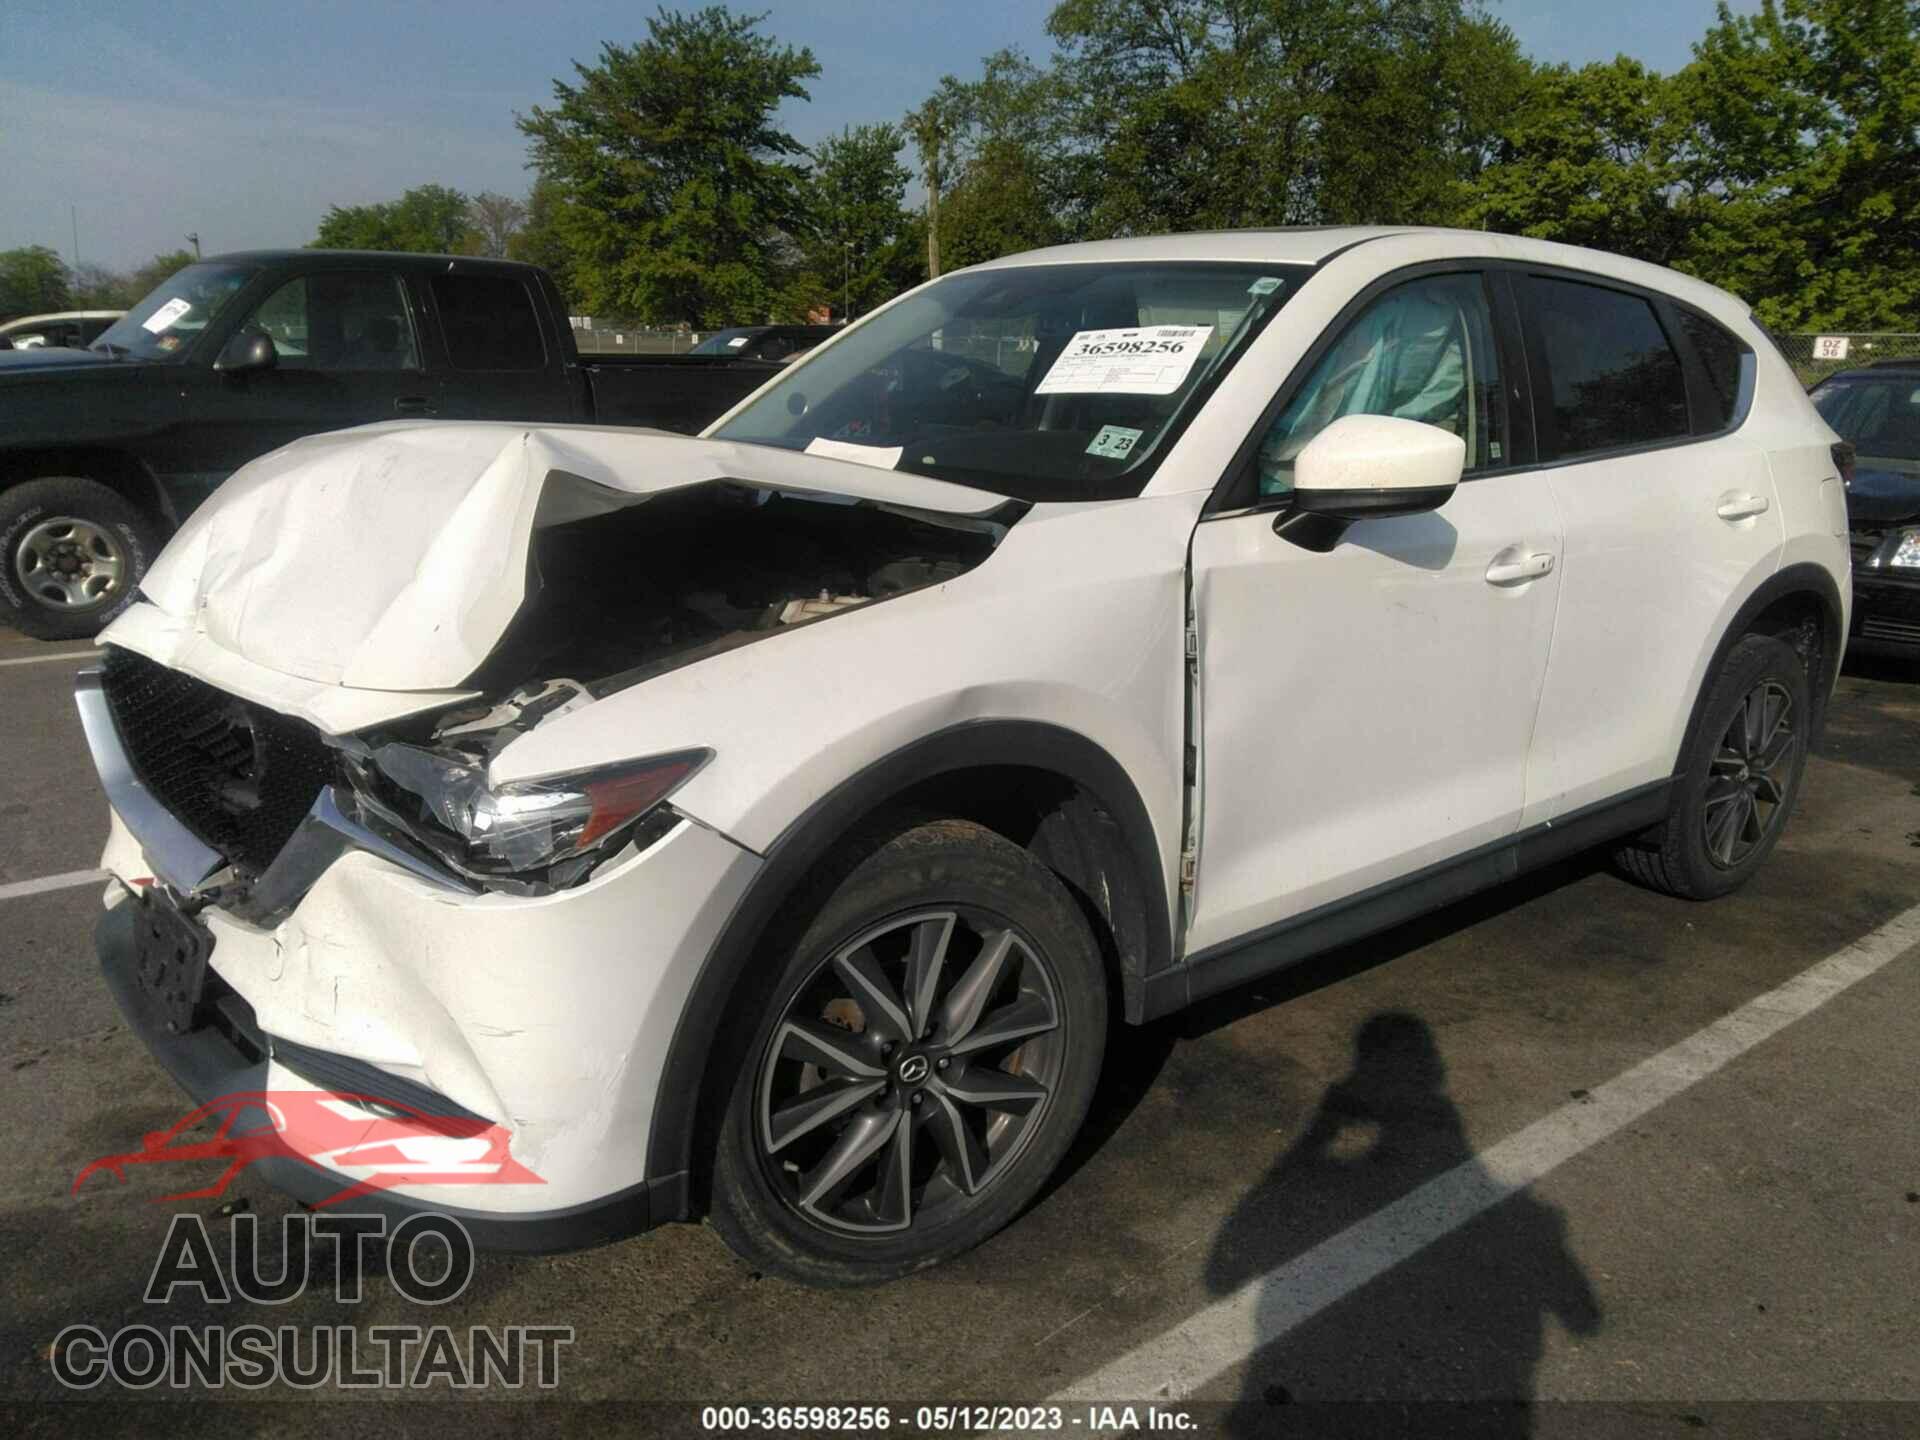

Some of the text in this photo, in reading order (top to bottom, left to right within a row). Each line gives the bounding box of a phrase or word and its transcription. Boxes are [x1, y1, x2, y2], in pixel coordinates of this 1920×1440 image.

[1074, 340, 1185, 356] 36598256
[1097, 434, 1133, 450] 3 23
